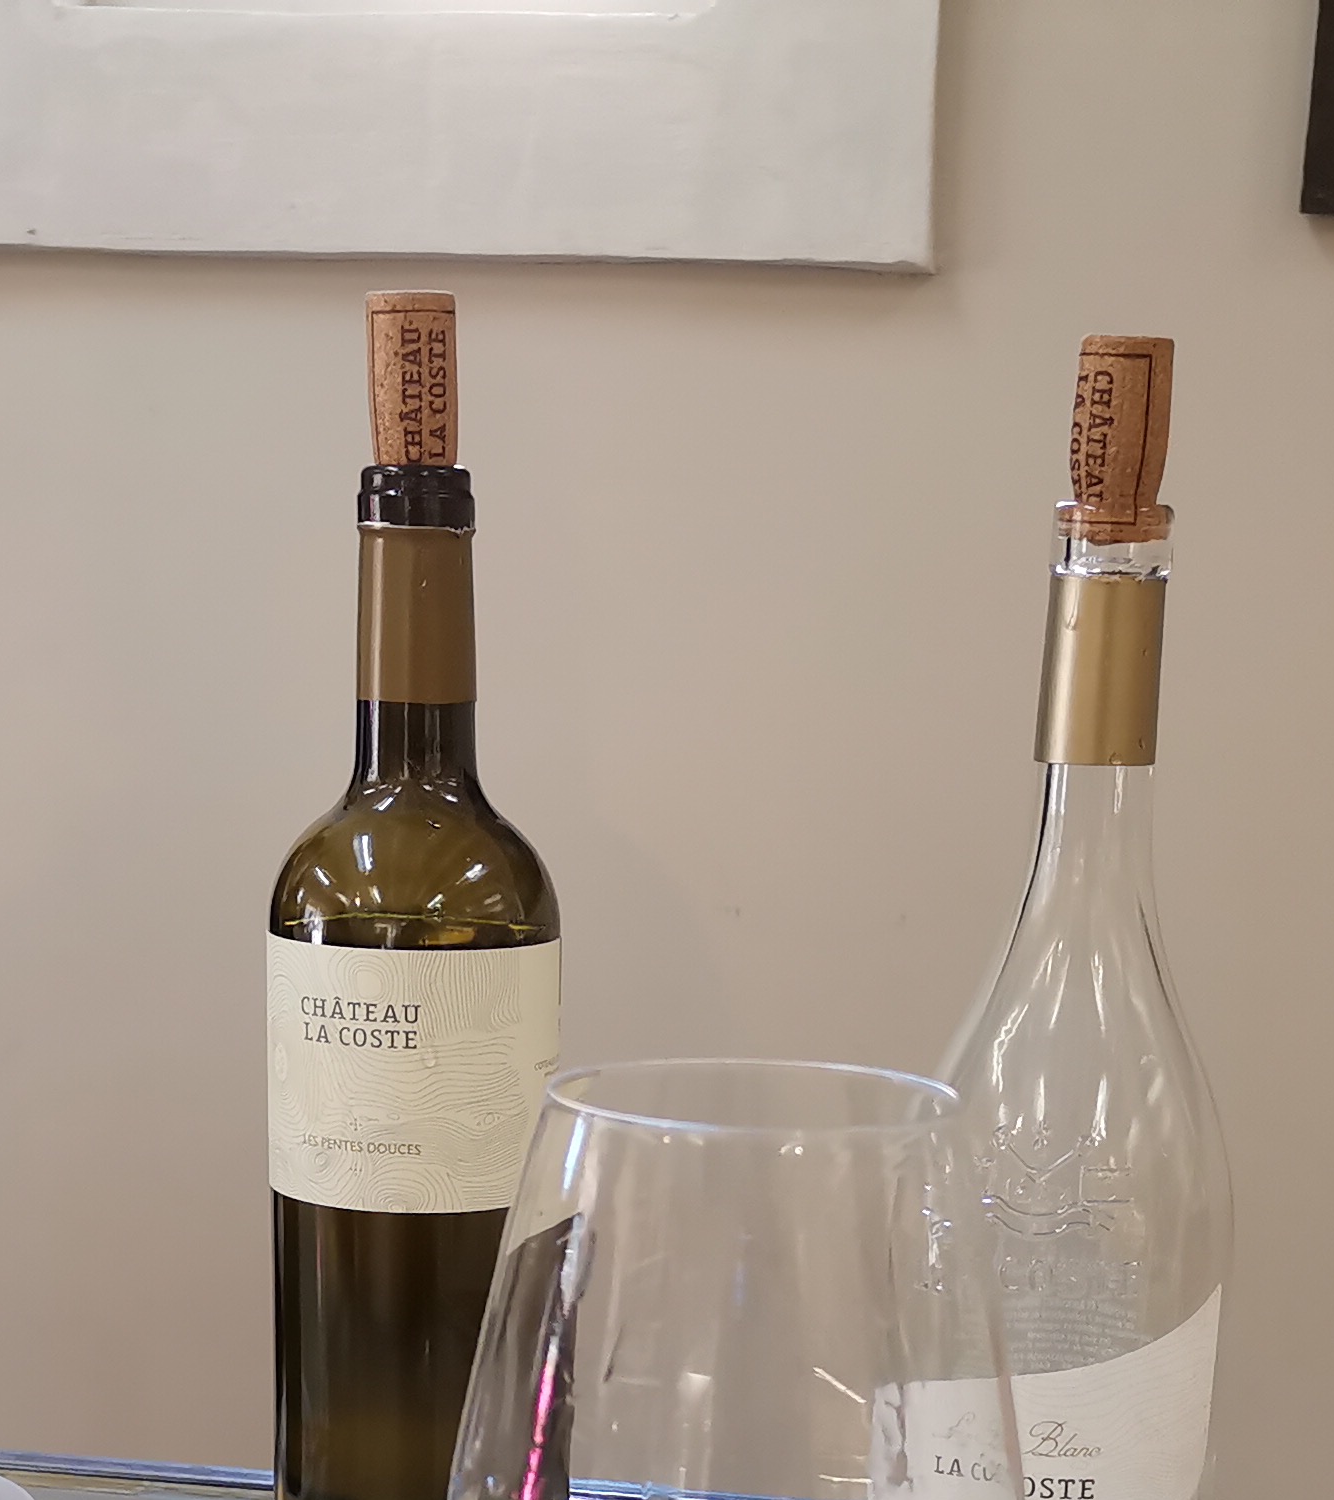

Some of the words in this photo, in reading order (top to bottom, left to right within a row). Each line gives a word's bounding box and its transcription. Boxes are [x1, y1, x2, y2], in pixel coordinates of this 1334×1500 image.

[428, 328, 447, 415] COSTE
[399, 325, 423, 464] CHÂTEAU
[428, 424, 447, 460] LA
[300, 996, 422, 1025] CHÂTEAU
[303, 1021, 331, 1045] LA
[339, 1026, 418, 1050] COSTE
[321, 1136, 364, 1153] PENTES
[367, 1141, 423, 1156] DOUCES
[1022, 1420, 1102, 1458] Blanc
[933, 1454, 964, 1478] LA
